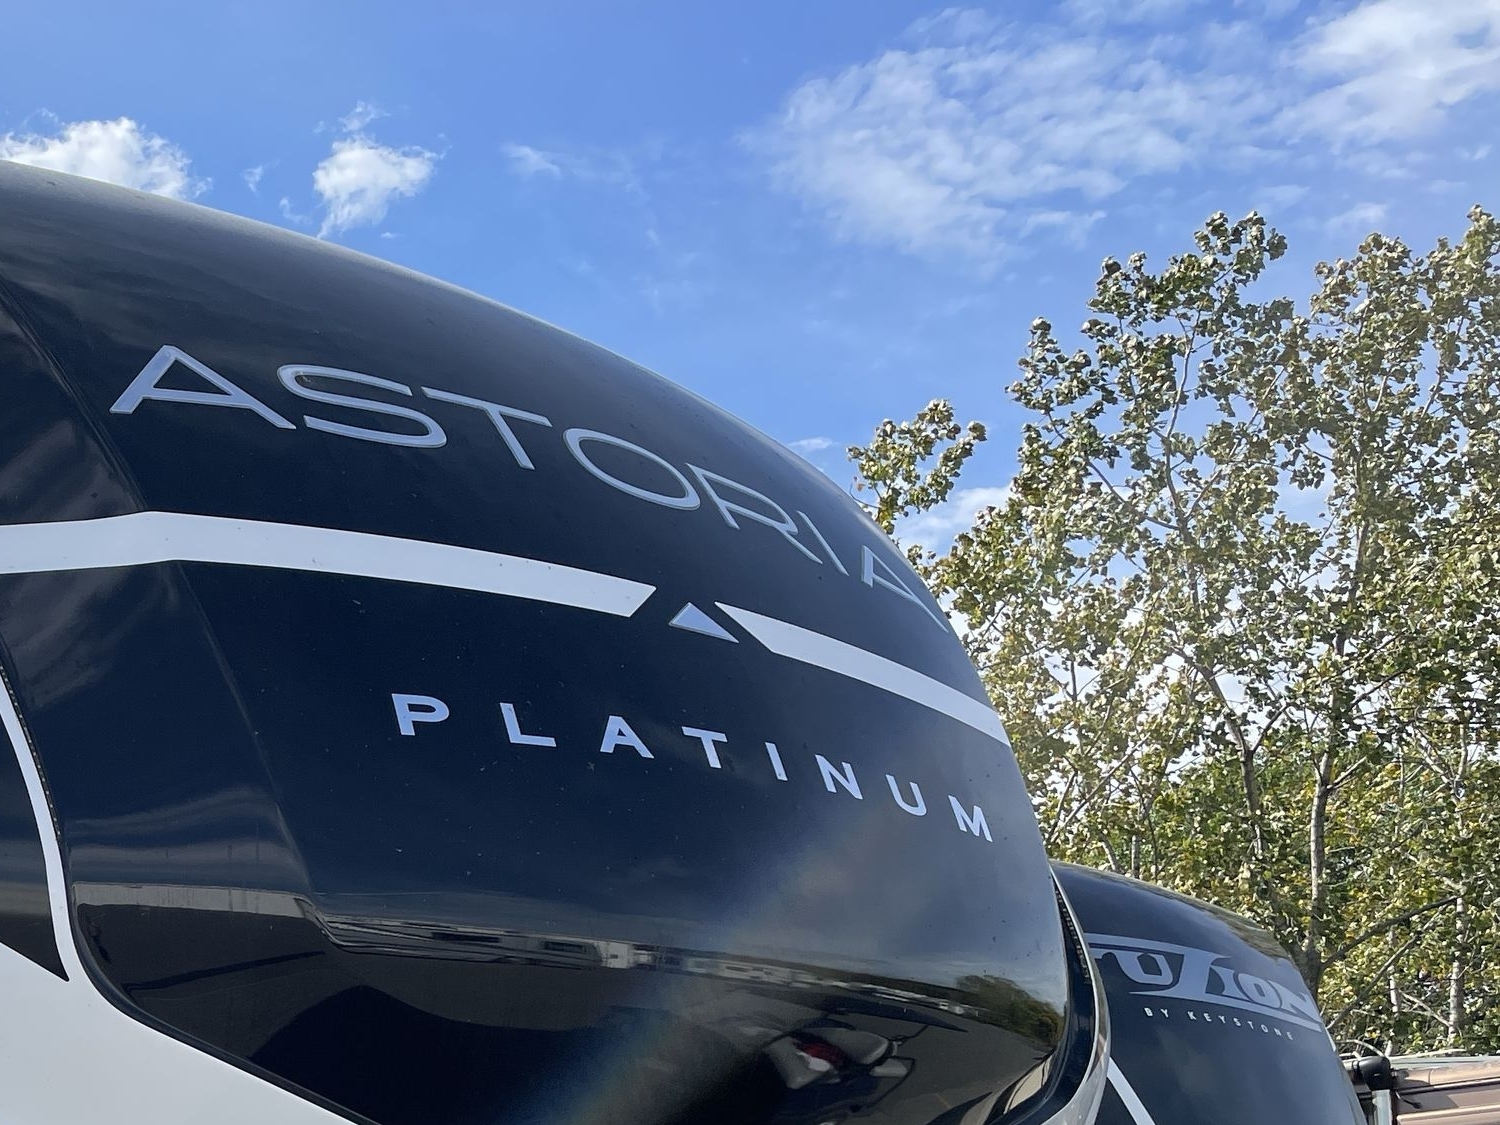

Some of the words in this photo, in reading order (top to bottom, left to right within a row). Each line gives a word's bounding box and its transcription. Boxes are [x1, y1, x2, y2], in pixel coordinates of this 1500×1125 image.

[109, 344, 948, 632] ASTORIA
[390, 692, 994, 843] PLATINUM
[1143, 1006, 1171, 1019] BY
[1187, 1010, 1294, 1042] KEYSTONE
